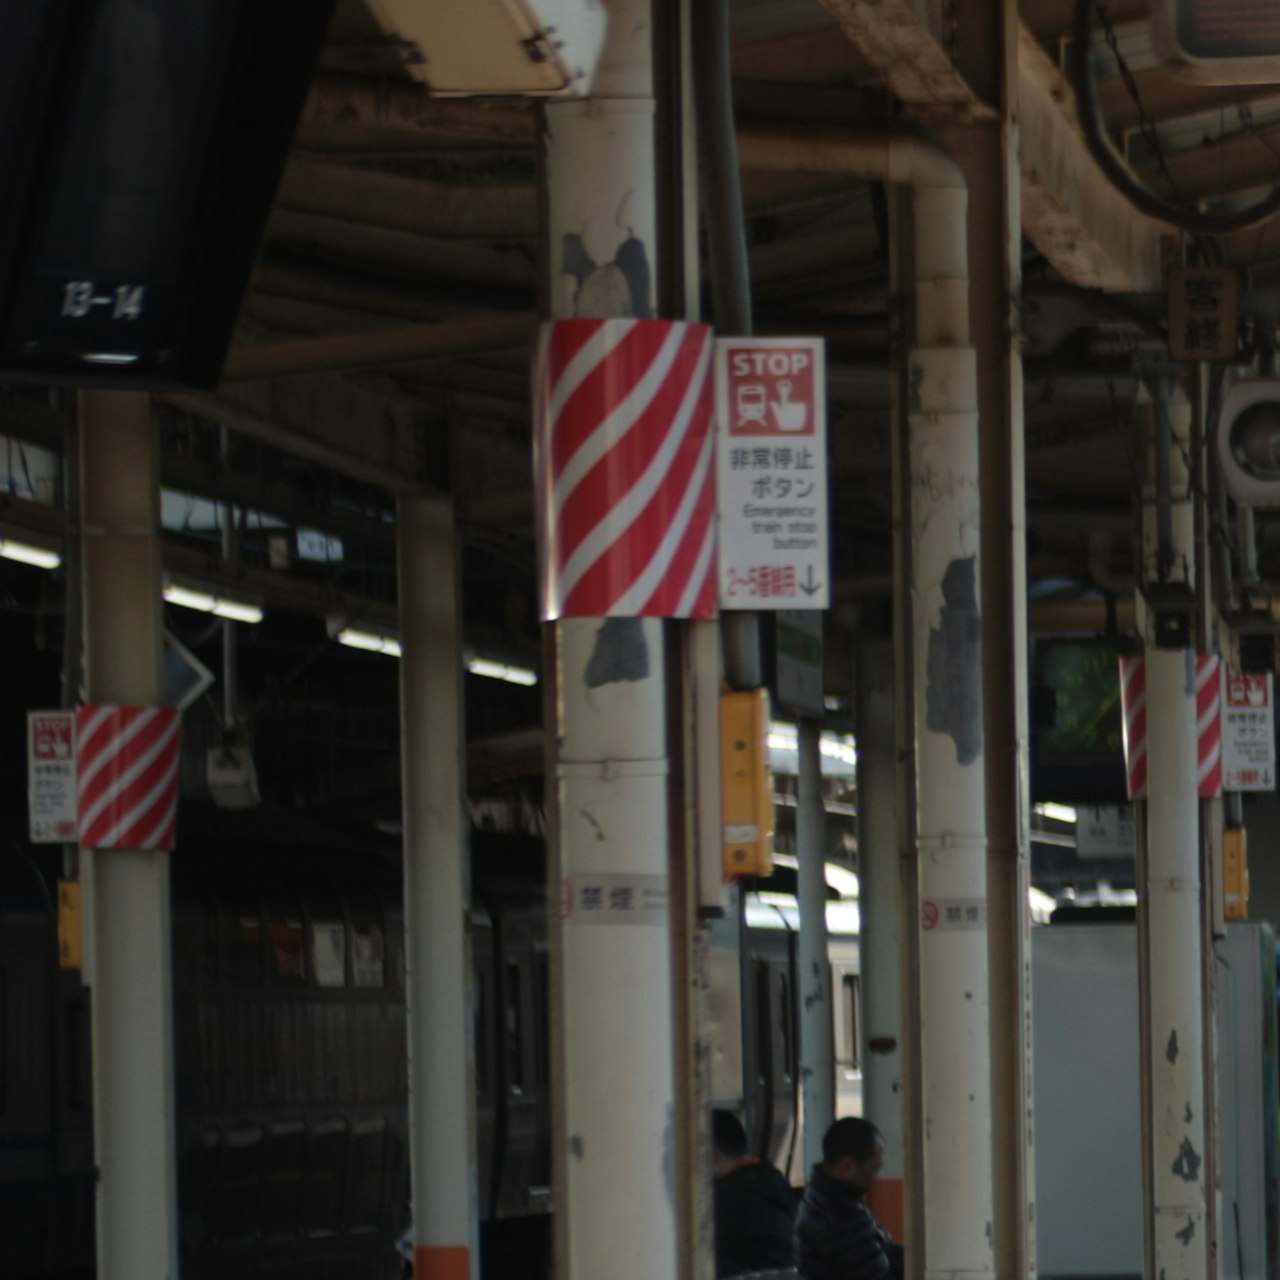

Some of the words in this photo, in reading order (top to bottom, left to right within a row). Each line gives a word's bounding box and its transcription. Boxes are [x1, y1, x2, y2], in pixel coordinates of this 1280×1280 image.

[733, 352, 809, 376] STOP
[730, 447, 815, 470] 非常停止
[752, 476, 815, 499] ボタン
[742, 503, 816, 519] Emergency
[752, 521, 781, 534] train
[788, 522, 817, 535] stop
[773, 537, 817, 550] button
